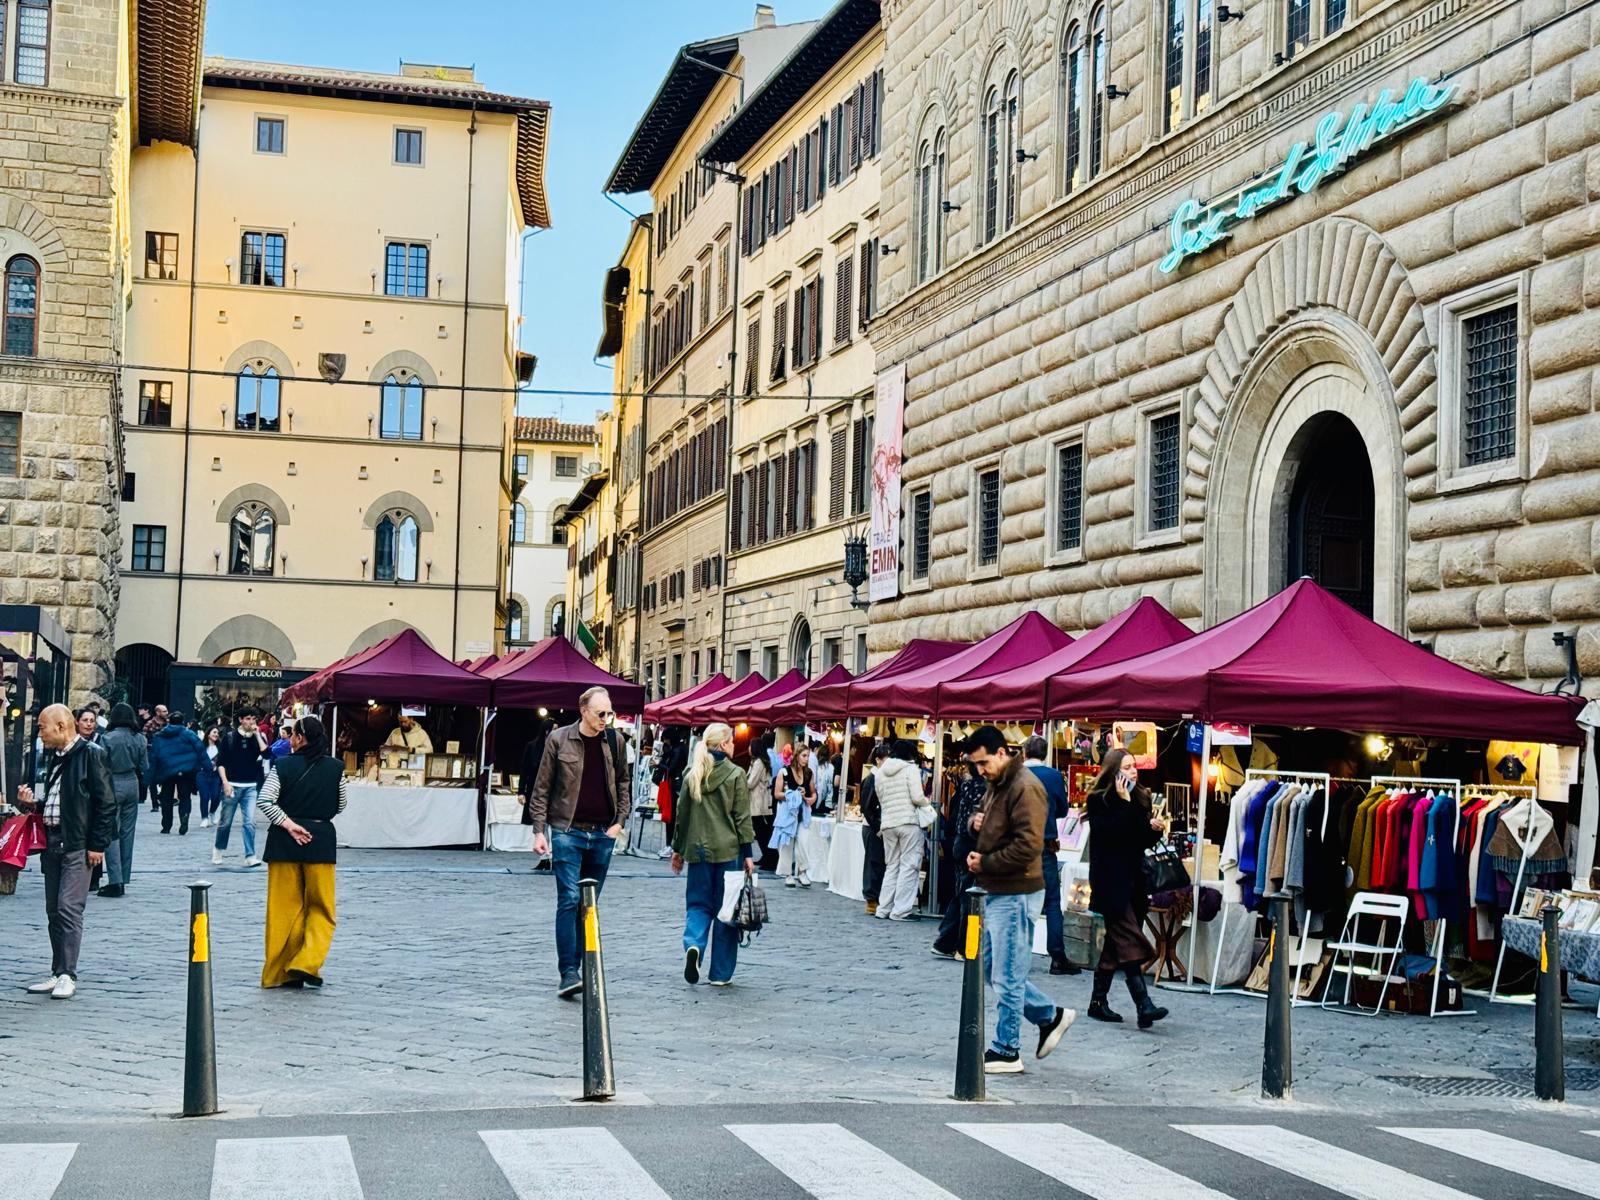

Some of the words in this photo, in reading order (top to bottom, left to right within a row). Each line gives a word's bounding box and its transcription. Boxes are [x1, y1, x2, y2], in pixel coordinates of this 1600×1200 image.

[1236, 142, 1306, 218] and
[872, 544, 897, 574] EMIN
[255, 669, 282, 678] ODEON
